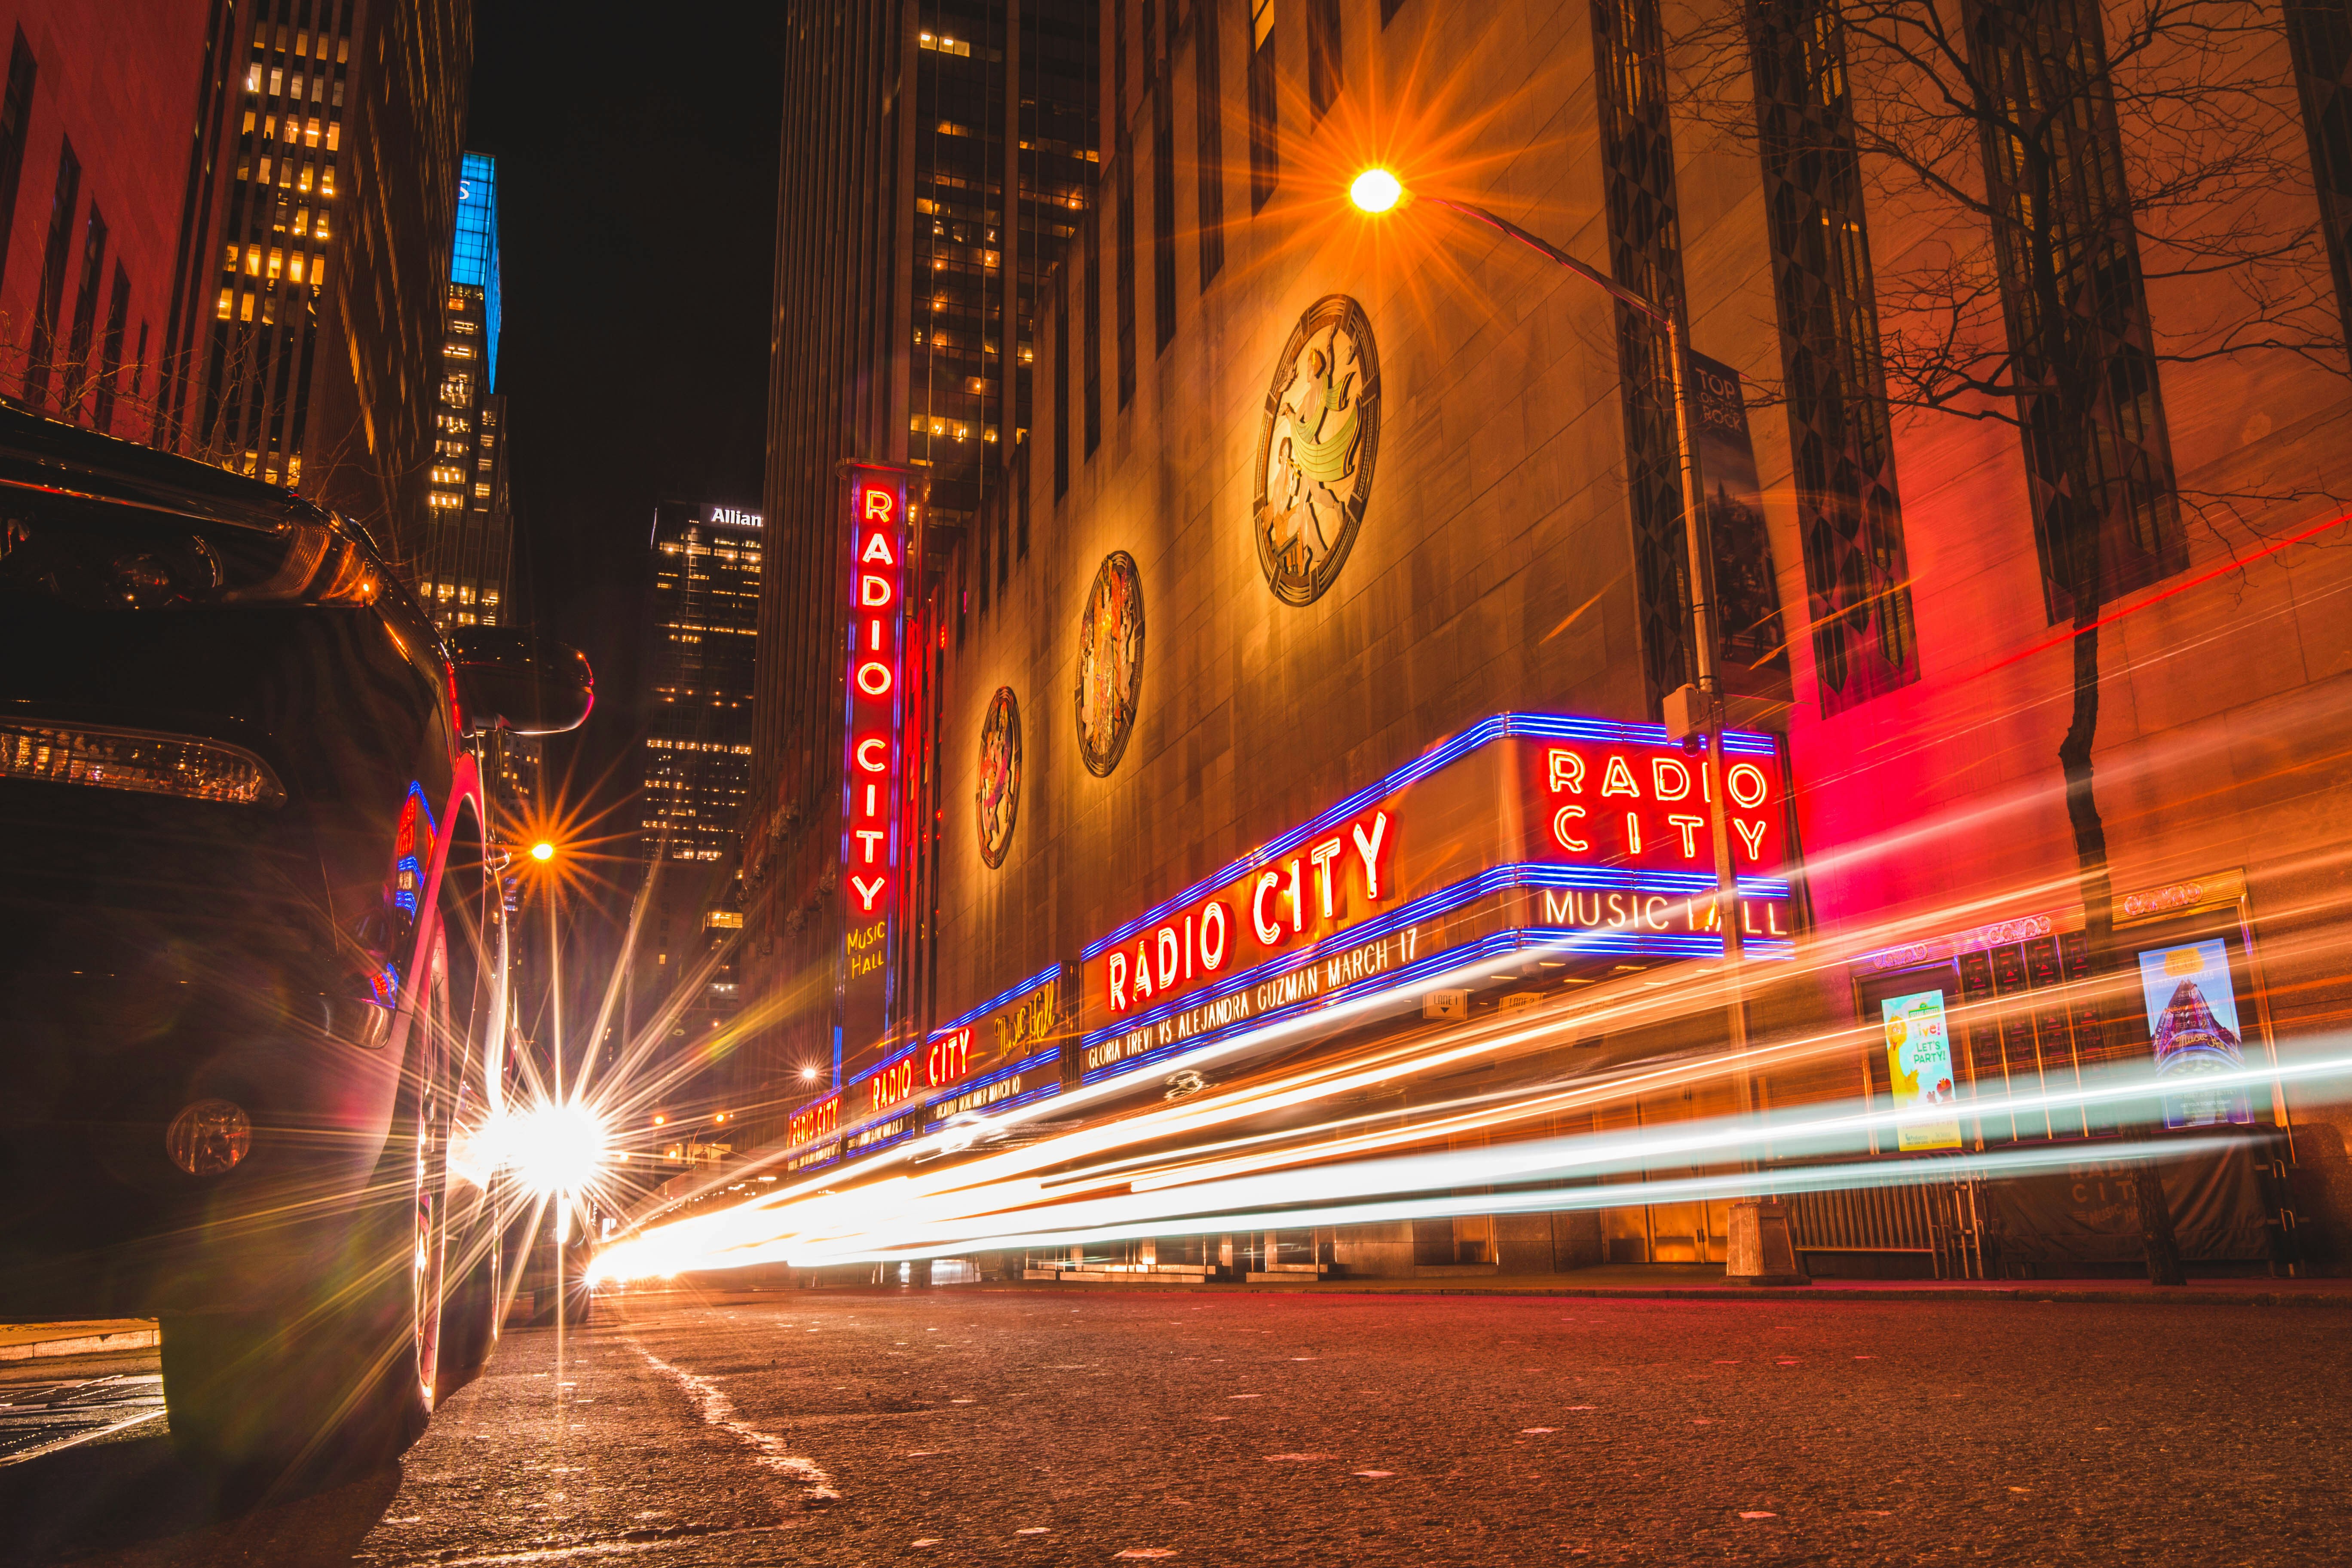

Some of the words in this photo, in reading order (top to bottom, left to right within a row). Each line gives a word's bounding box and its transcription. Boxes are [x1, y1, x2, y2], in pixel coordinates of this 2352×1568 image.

[1695, 367, 1735, 399] TOP
[1703, 405, 1743, 432] ROCK
[711, 508, 763, 527] Allian
[857, 489, 893, 695] RADIO
[1548, 748, 1767, 808] RADIO
[851, 738, 885, 911] CITY
[1553, 805, 1766, 861] CITY
[1110, 901, 1225, 1011] RADIO
[1253, 811, 1387, 945] CITY
[1546, 890, 1669, 930] MUSIC
[1687, 898, 1787, 934] LL
[848, 922, 885, 955] MUSIC
[852, 950, 884, 980] HALL
[2171, 959, 2197, 970] TOUR
[1089, 1038, 1120, 1069] GLORIA
[1127, 1030, 1152, 1056] TREVI
[1159, 1023, 1171, 1043] VS
[1178, 991, 1250, 1039] ALEJANDRA
[1258, 968, 1317, 1009] GUZMAN
[1328, 939, 1387, 983] MARCH
[1400, 928, 1417, 963] 17
[1434, 995, 1452, 1005] LANE
[1455, 995, 1458, 1005] 1
[1510, 998, 1526, 1008] LANE
[1023, 980, 1055, 1055] Hall
[1914, 1050, 1946, 1064] PARTY!
[1916, 1041, 1941, 1052] LET'S
[873, 1059, 912, 1112] RADIO
[928, 1028, 970, 1087] CITY
[936, 1099, 957, 1119] RICARDO
[989, 1079, 1010, 1102] MARCH
[1012, 1075, 1020, 1094] 10
[793, 1112, 814, 1147] RADIO
[818, 1097, 838, 1136] CITY
[2068, 1160, 2125, 1180] RAD
[2072, 1180, 2132, 1203] CIT
[2089, 1203, 2122, 1225] MUSIC
